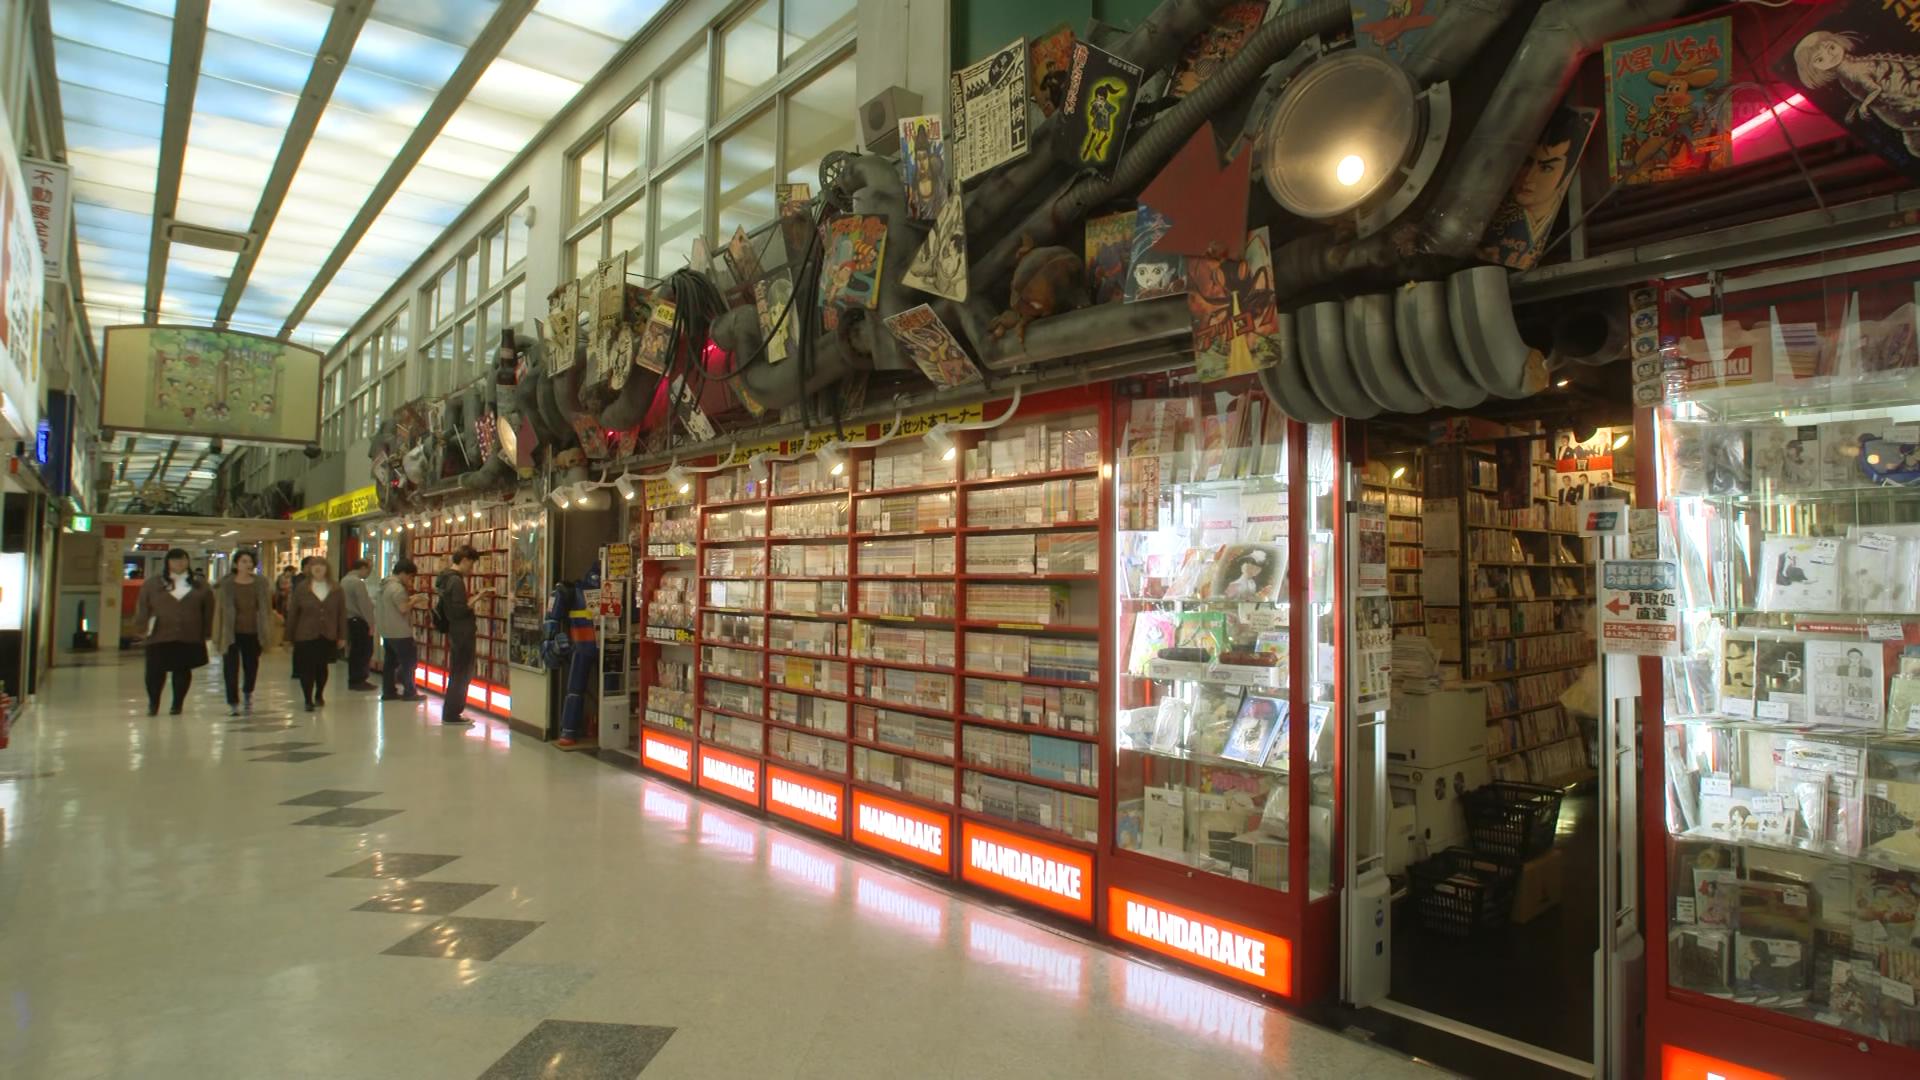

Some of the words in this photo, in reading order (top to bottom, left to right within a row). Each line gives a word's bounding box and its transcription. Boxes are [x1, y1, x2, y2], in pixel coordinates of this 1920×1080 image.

[1615, 44, 1655, 80] 火星
[1629, 592, 1676, 607] 買取処
[1636, 607, 1668, 621] 直進
[771, 778, 838, 821] MANDARAKE
[859, 804, 942, 856] MANDARAKE
[971, 838, 1081, 900] MANDARAKE
[1126, 901, 1266, 977] MANDARAKE
